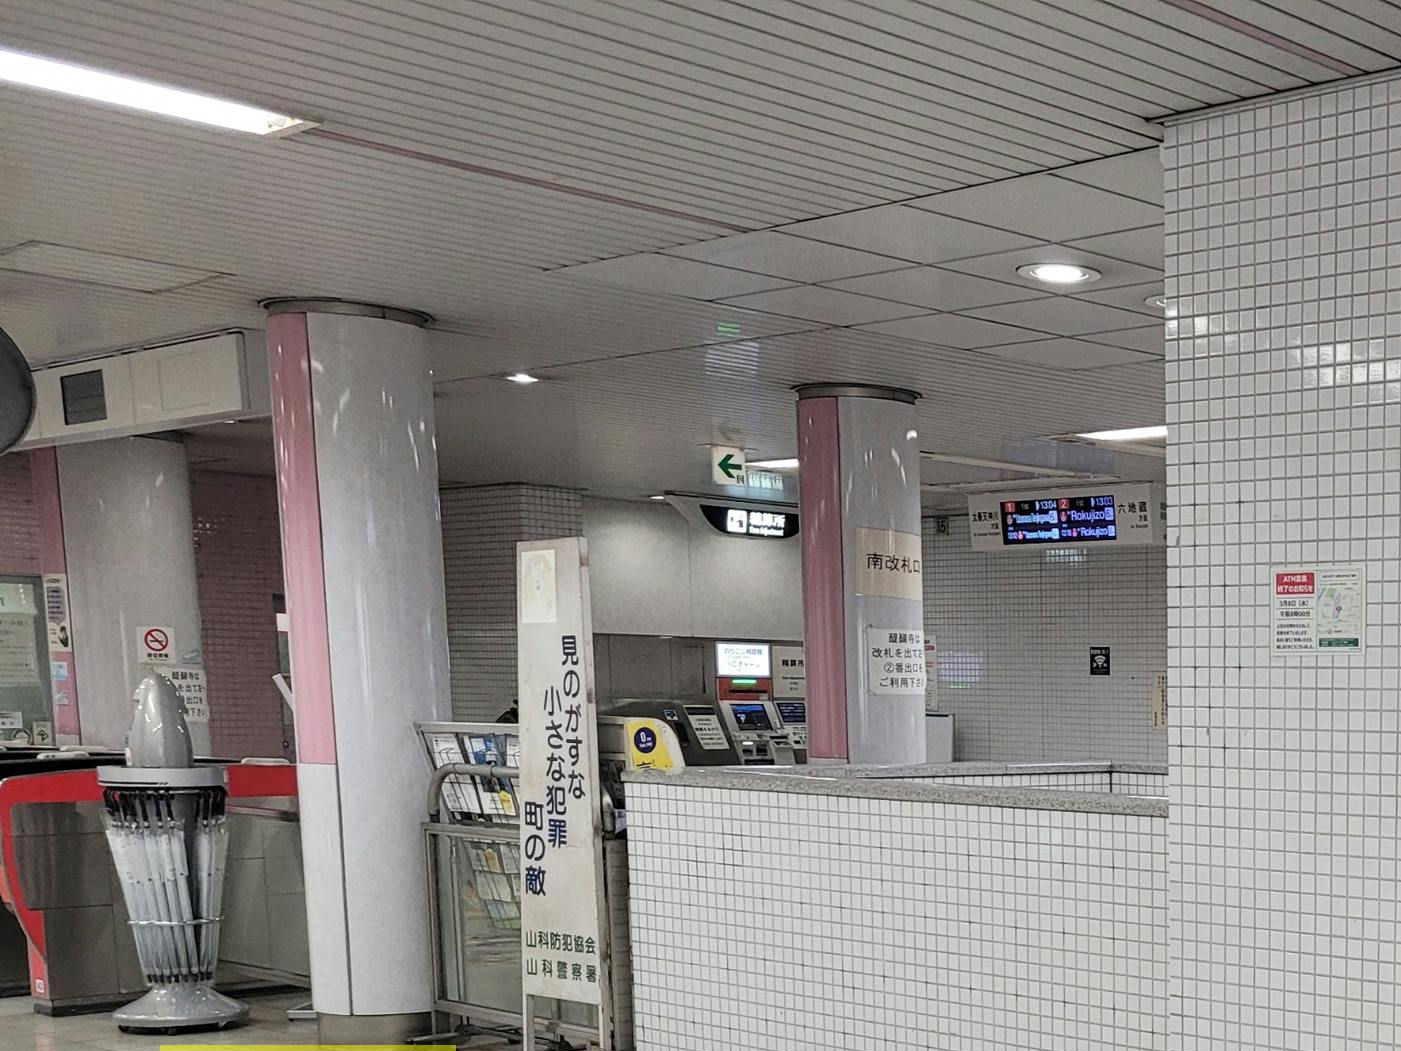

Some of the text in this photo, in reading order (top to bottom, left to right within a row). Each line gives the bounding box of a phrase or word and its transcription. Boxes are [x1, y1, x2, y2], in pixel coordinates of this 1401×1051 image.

[1040, 501, 1057, 509] 13:04
[1096, 497, 1113, 506] 13:03
[1070, 509, 1105, 523] Rokujizo
[866, 552, 921, 574] 南改札口
[561, 634, 586, 800] 見のがすな
[543, 685, 568, 849] 小さな犯罪
[524, 801, 547, 897] 町の敵
[525, 929, 597, 956] 山科防犯協会
[526, 957, 598, 984] 山科警察署
